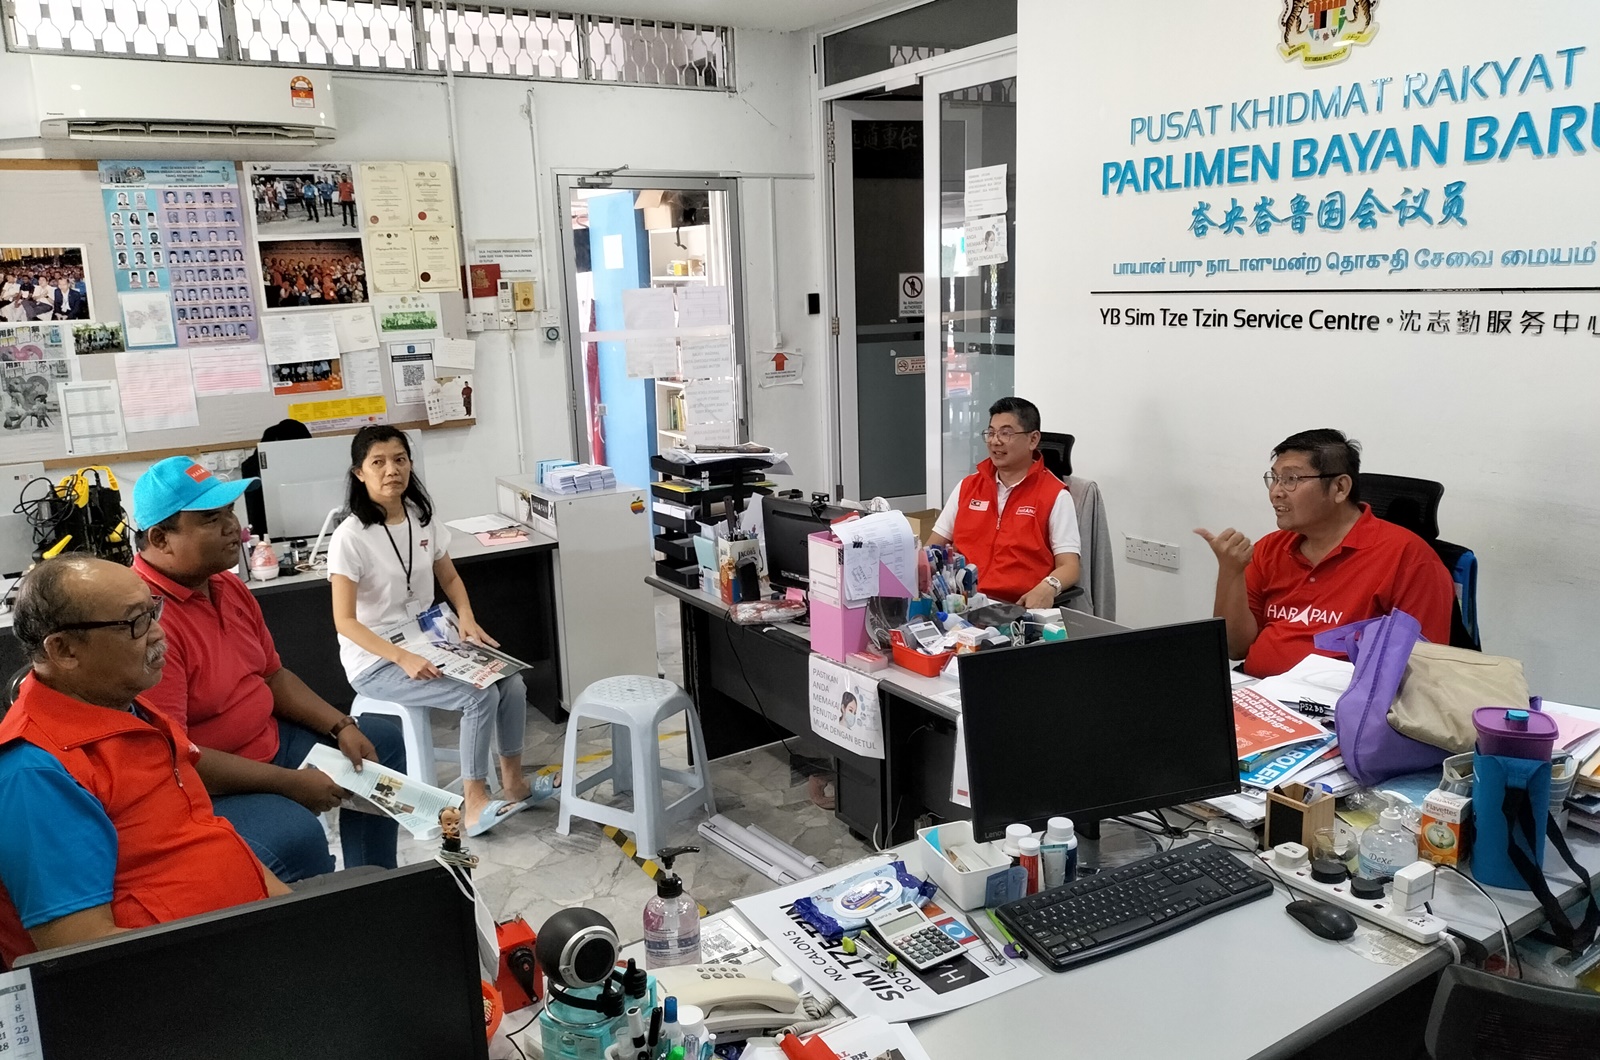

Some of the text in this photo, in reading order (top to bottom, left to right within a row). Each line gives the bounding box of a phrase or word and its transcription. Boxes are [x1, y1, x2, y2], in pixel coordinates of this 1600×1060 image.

[1130, 46, 1586, 145] PUSAT KHIDMAT RAKYAT
[1102, 142, 1281, 196] PARLIMEN
[1291, 121, 1450, 179] BAYAN
[1099, 307, 1380, 331] YB Sim Tze Tzin Service Centre
[1266, 604, 1343, 626] HARAPAN
[812, 667, 839, 684] PASTIKAN
[812, 680, 830, 693] ANDA
[812, 693, 840, 710] MEMAKAI
[812, 705, 838, 722] PENUTUP
[1232, 695, 1296, 734] ntarabangsa
[813, 717, 877, 750] MUKA DENGAN BETUL
[1248, 749, 1307, 784] BOLEH
[1426, 802, 1457, 817] Flavettes
[797, 938, 829, 967] CALON
[852, 968, 905, 1002] SIM
[14, 1004, 22, 1012] 8
[15, 1014, 25, 1023] 15
[15, 1024, 28, 1034] 22
[17, 1035, 30, 1046] 29
